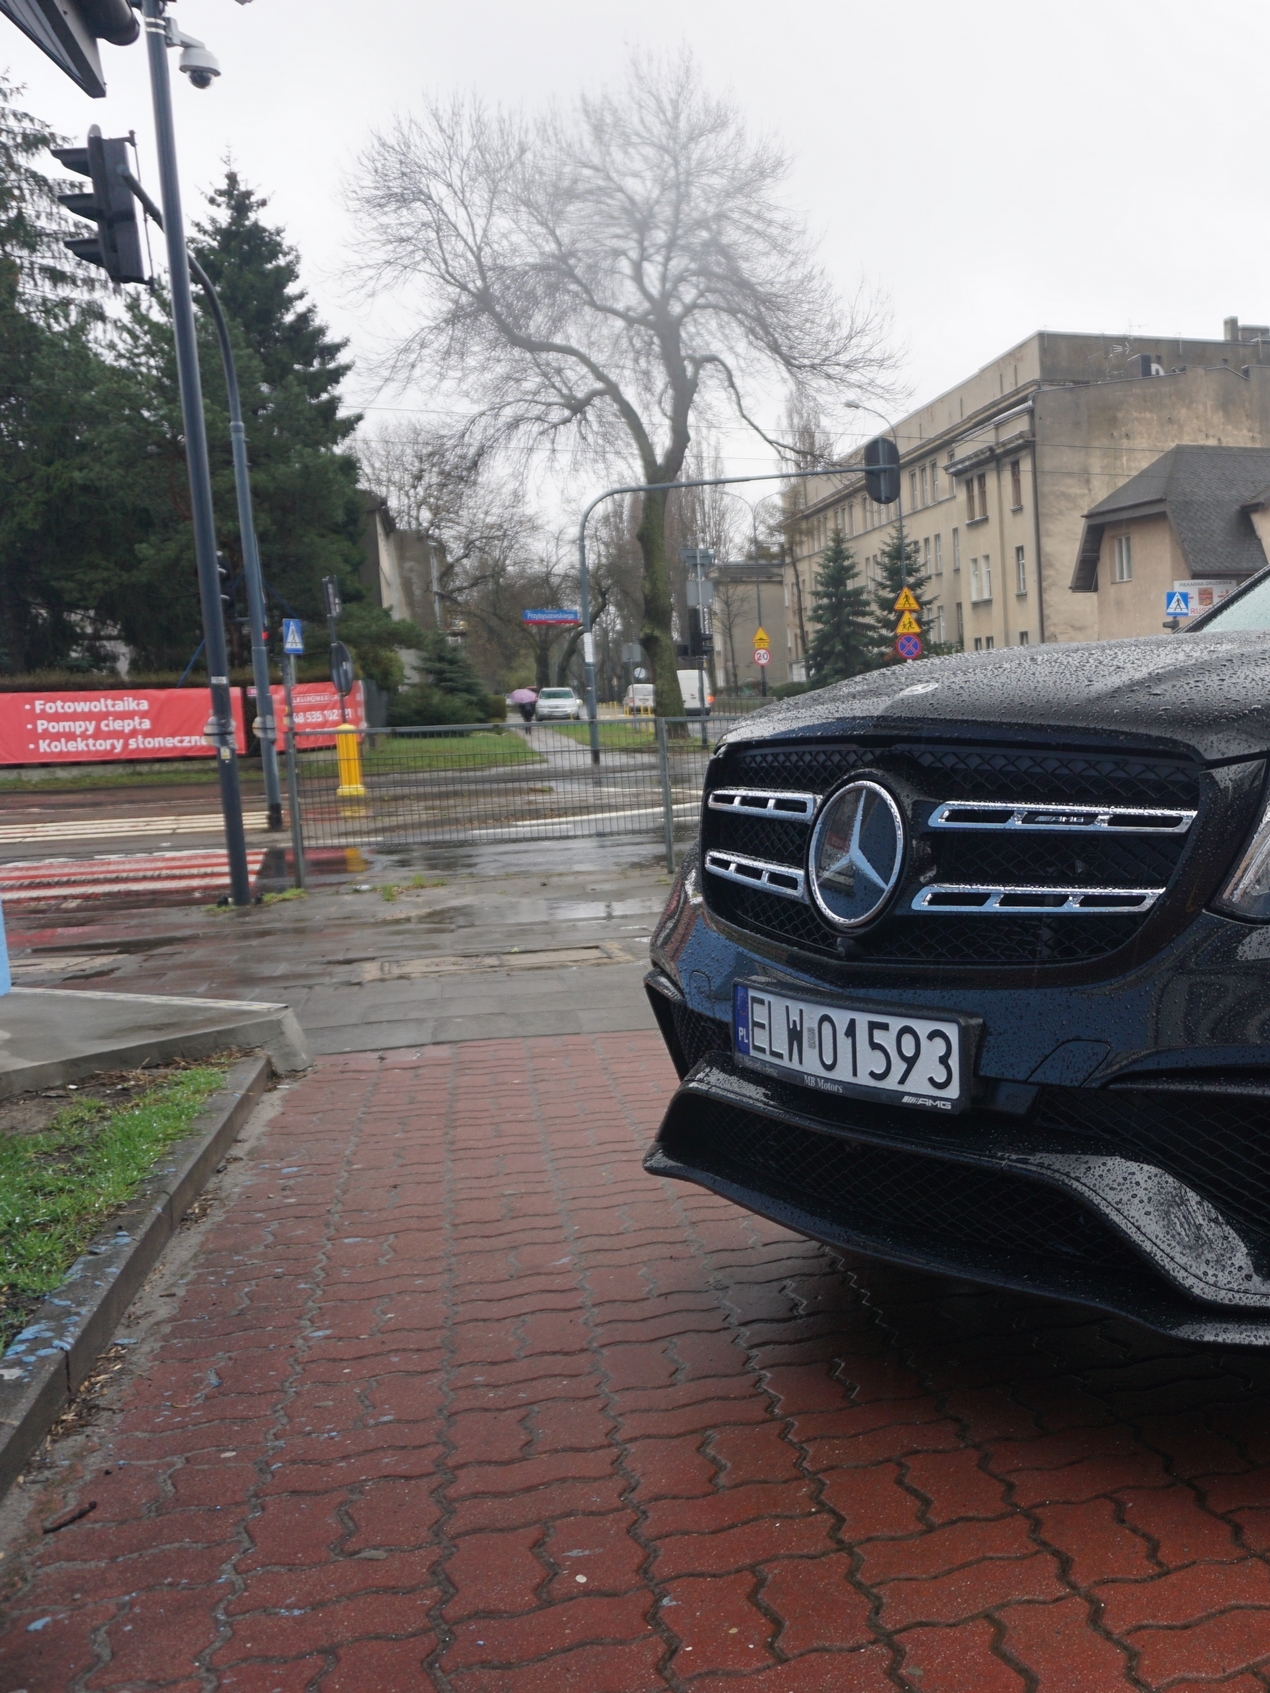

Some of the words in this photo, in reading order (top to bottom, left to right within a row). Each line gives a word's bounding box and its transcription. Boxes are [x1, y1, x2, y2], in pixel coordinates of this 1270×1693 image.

[527, 612, 575, 620] Przybyszewskiego
[756, 652, 769, 661] 20
[35, 697, 149, 713] Fotowoltaika
[306, 711, 322, 722] 535
[37, 719, 96, 734] Pompy
[100, 716, 151, 731] ciepła
[38, 737, 124, 752] Kolektory
[1050, 815, 1084, 823] AMG
[738, 1026, 749, 1044] PL
[750, 994, 804, 1066] ELW
[817, 1013, 953, 1090] 01593
[804, 1074, 816, 1087] MB
[817, 1078, 843, 1094] Motors
[917, 1097, 952, 1110] AMG
